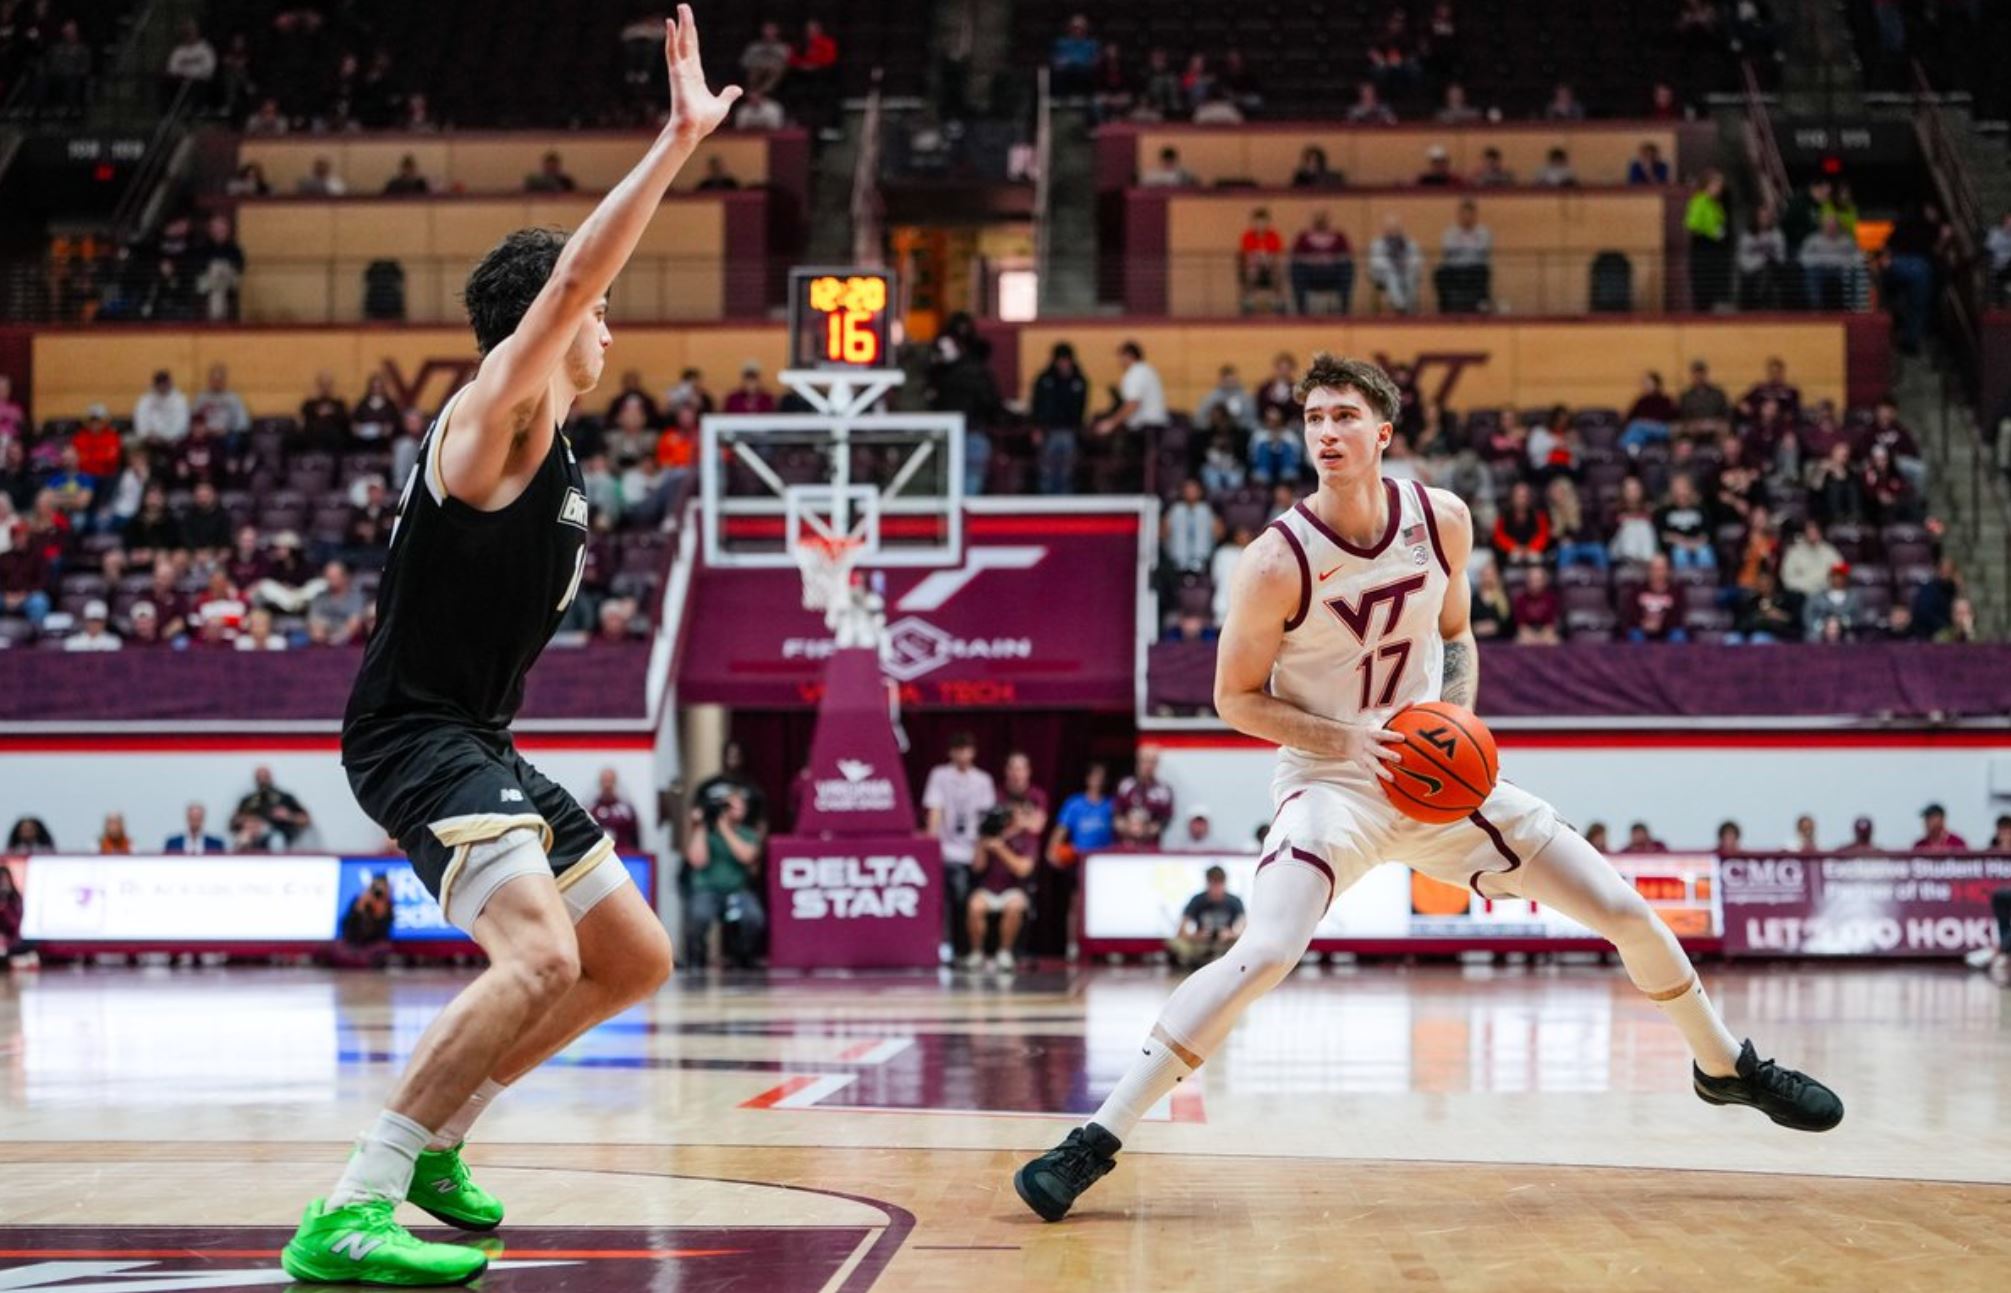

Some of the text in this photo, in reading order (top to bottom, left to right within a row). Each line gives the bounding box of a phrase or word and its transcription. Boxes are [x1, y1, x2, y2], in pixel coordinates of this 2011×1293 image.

[828, 311, 876, 362] 16
[1323, 571, 1428, 646] VT
[1356, 637, 1413, 712] 17
[501, 788, 524, 802] NB
[780, 855, 928, 889] DELTA
[1721, 859, 1803, 887] CMG
[1911, 858, 1983, 879] Student
[791, 887, 919, 919] STAR
[1895, 880, 1917, 901] of
[1919, 880, 1950, 901] the
